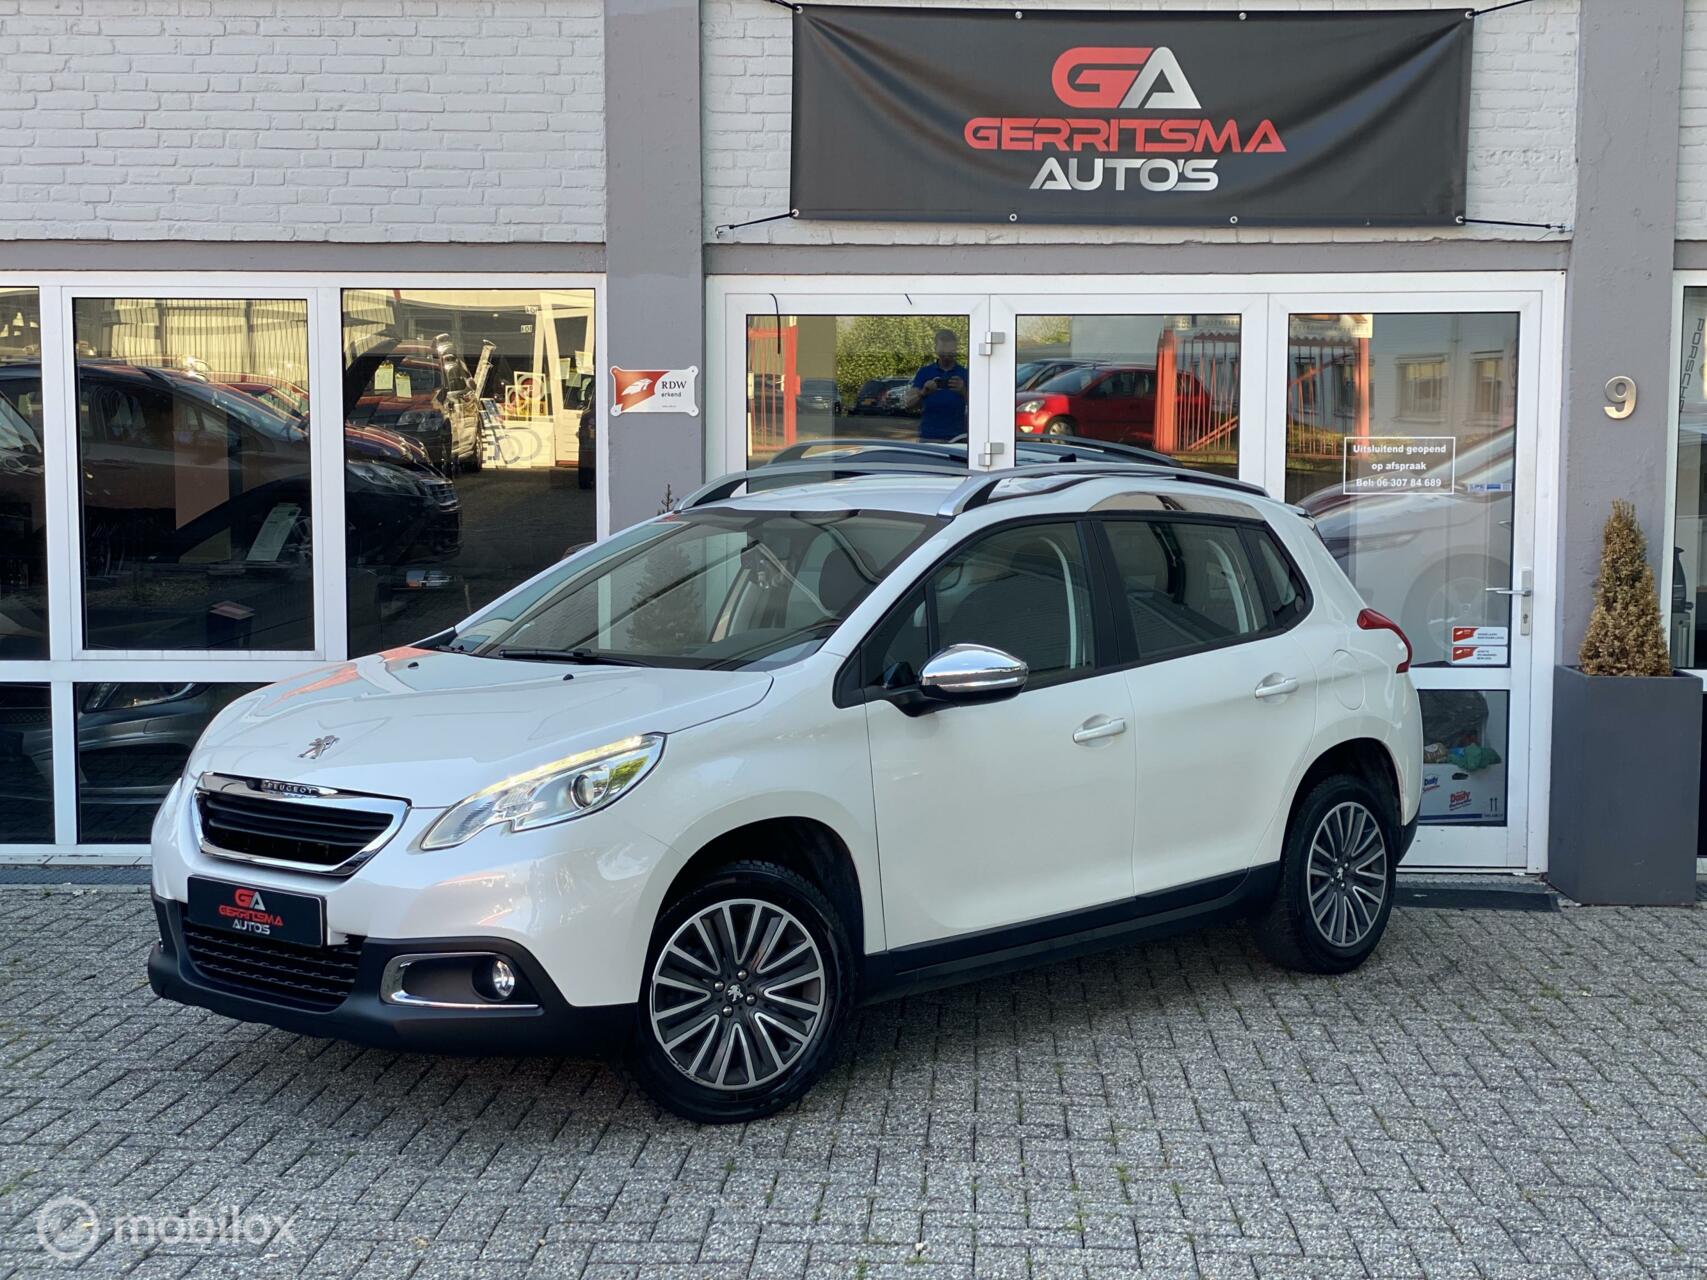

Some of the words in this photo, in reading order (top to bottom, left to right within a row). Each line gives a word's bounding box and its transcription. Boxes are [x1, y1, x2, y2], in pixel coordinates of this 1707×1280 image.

[1051, 46, 1202, 109] GA
[963, 117, 1287, 153] GERRITSMA
[1029, 157, 1219, 192] AUTO'S
[661, 380, 687, 390] RDW
[1603, 375, 1637, 420] 9
[1353, 444, 1404, 454] Uitsluitend
[1406, 444, 1447, 455] geopend
[1371, 463, 1383, 472] op
[1385, 461, 1427, 472] afspraak
[1356, 478, 1374, 487] Bel:
[1410, 478, 1422, 487] 84
[1424, 478, 1442, 487] 689
[267, 781, 313, 794] PEUGEOT
[234, 888, 266, 911] GA
[218, 904, 284, 927] GERRITSMA
